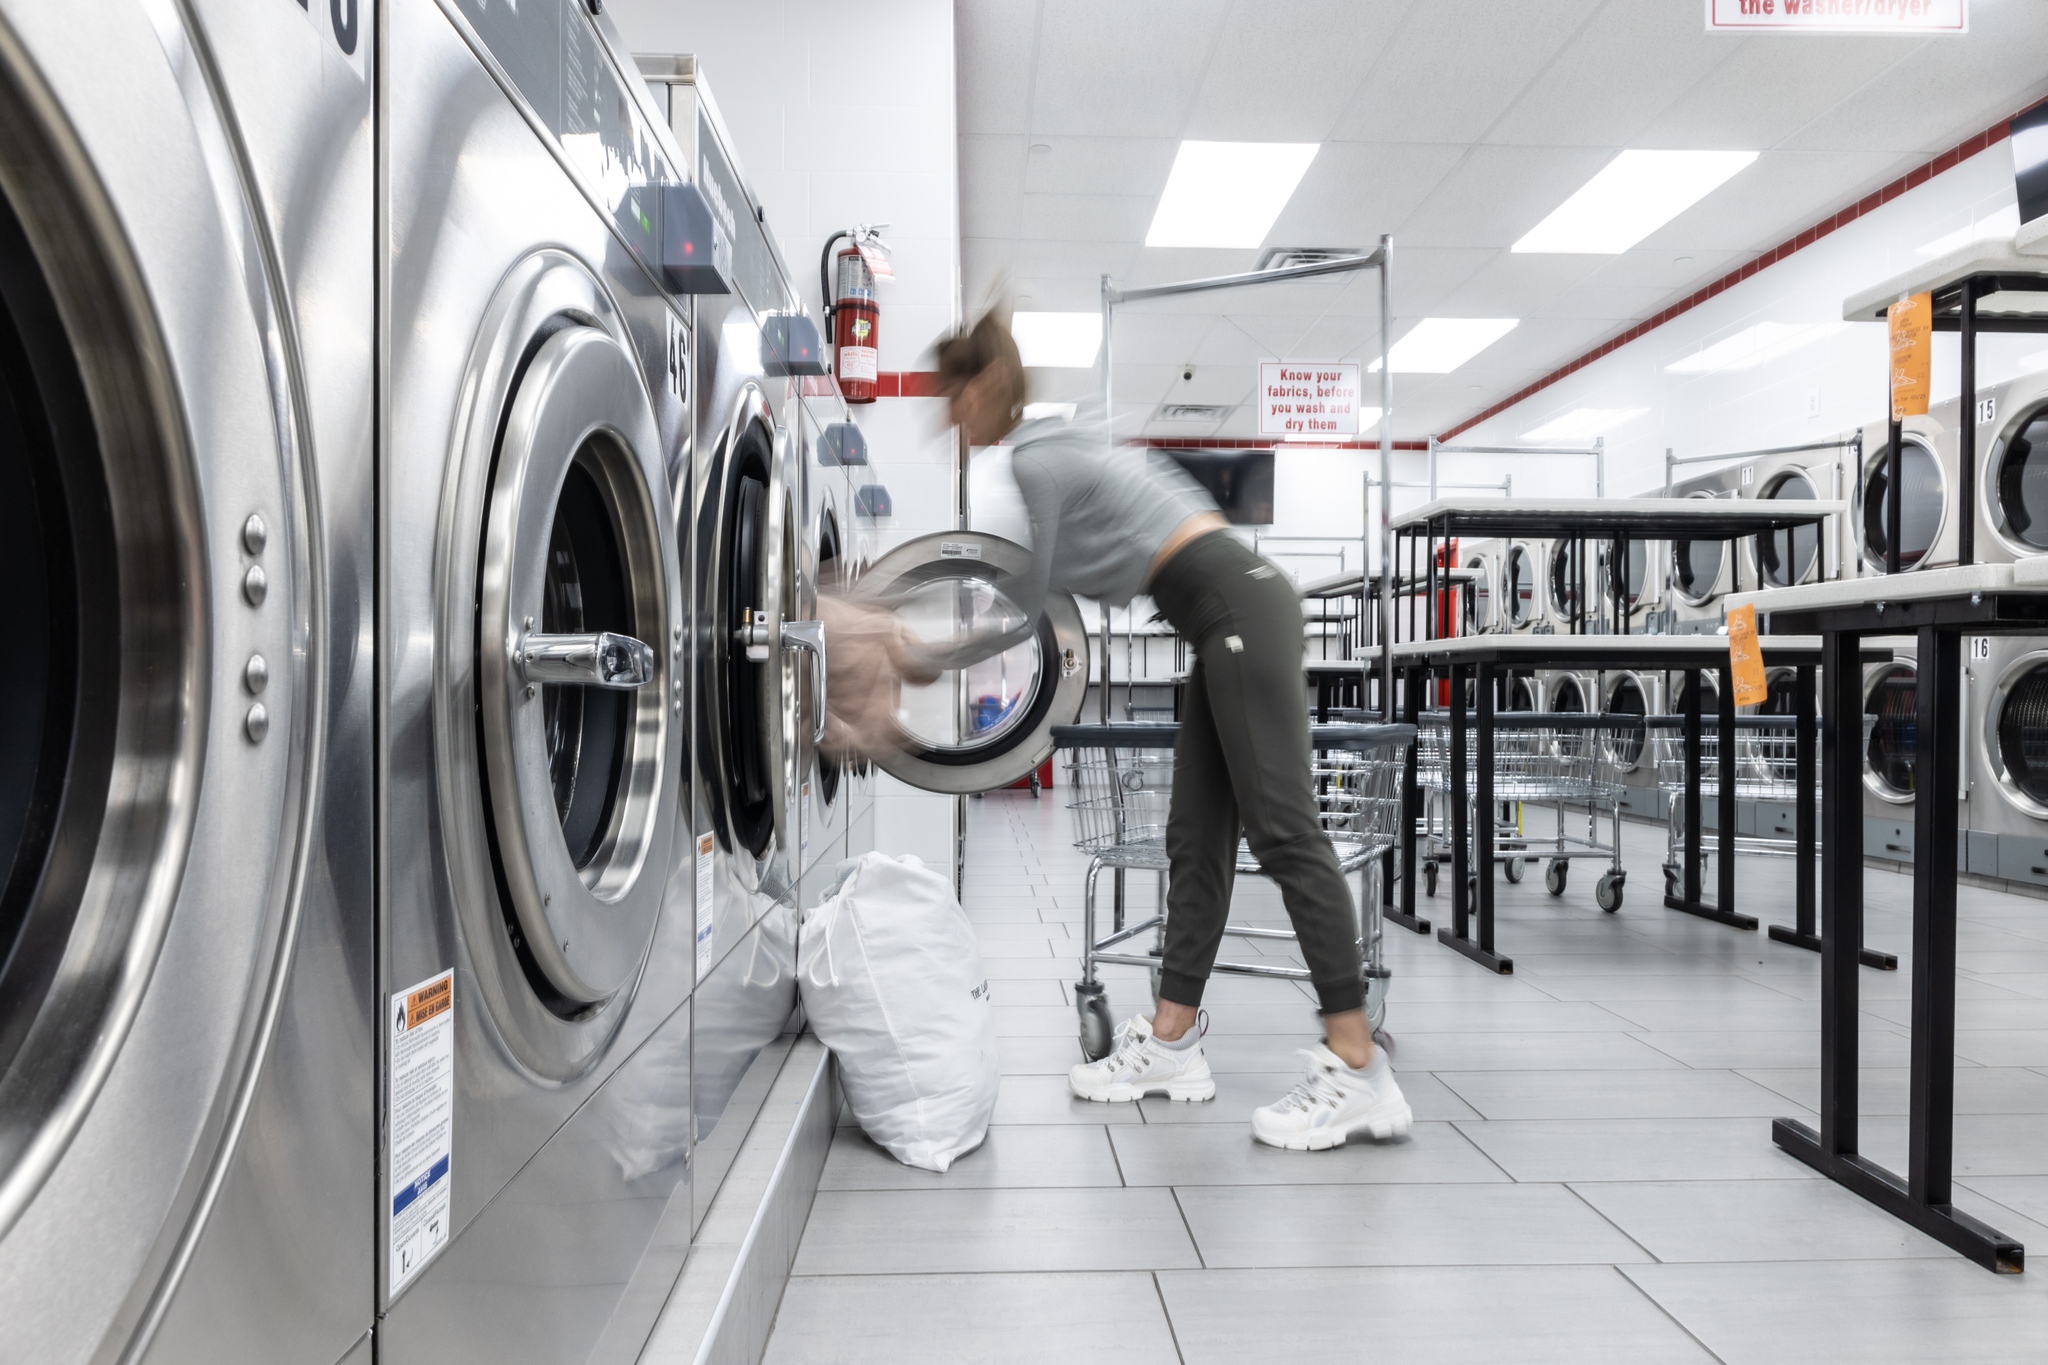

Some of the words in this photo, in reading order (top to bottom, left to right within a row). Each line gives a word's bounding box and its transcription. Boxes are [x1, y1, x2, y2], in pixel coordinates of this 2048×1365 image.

[1739, 0, 1774, 15] the
[669, 316, 687, 404] 46
[1281, 368, 1312, 381] Know
[1316, 372, 1342, 383] your
[1268, 385, 1312, 399] fabrics,
[1317, 386, 1354, 397] before
[1272, 404, 1291, 415] you
[1296, 402, 1325, 413] wash
[1330, 403, 1350, 414] and
[1980, 399, 1993, 422] 15
[1286, 418, 1304, 432] dry
[1308, 418, 1337, 430] them
[1743, 467, 1752, 484] 11
[1974, 638, 1988, 658] 16
[418, 979, 448, 1003] WARNING
[971, 986, 982, 1000] THE
[416, 1007, 428, 1022] MISE
[429, 1003, 435, 1016] EN
[436, 995, 450, 1012] GARDE
[414, 1169, 431, 1189] NOTICE
[417, 1181, 428, 1196] AVIS
